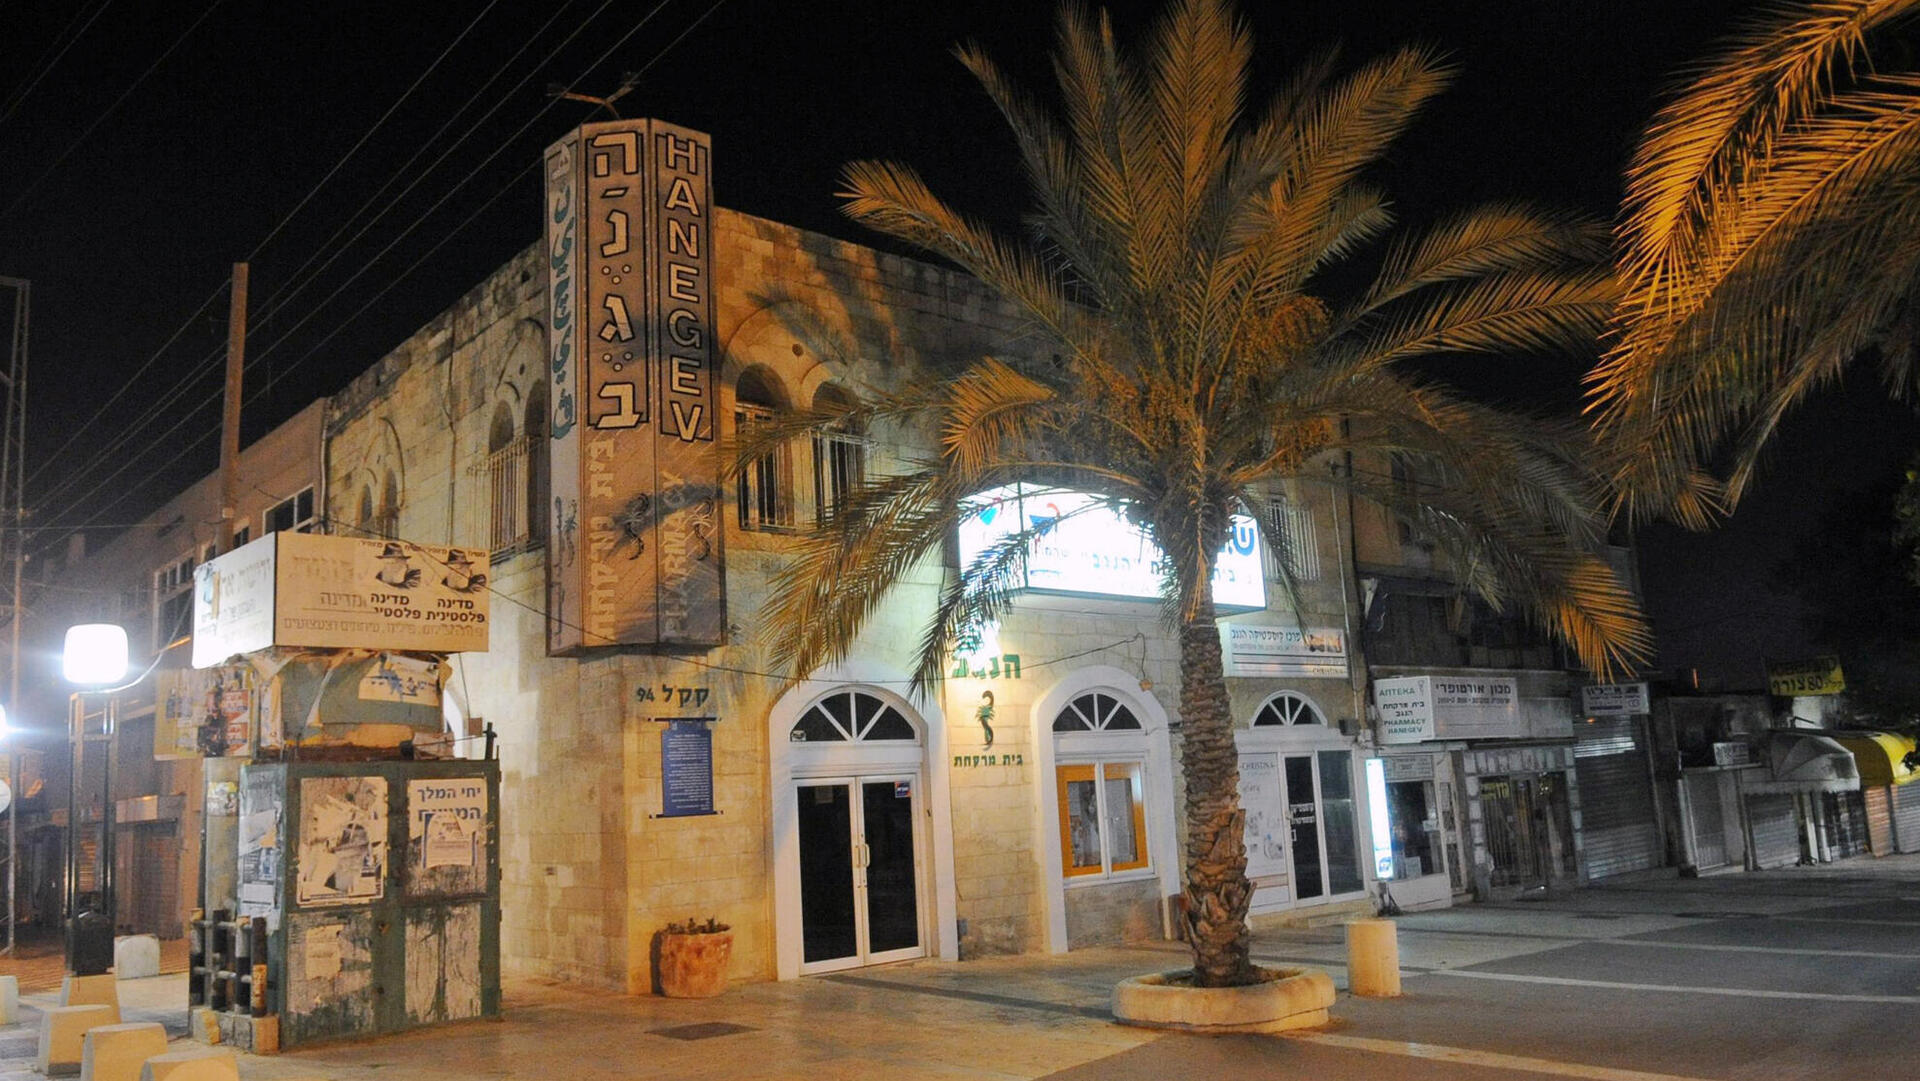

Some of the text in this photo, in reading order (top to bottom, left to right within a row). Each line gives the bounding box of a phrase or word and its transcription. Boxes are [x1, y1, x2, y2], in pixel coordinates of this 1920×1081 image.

[666, 133, 707, 443] HANEGEV
[370, 592, 411, 607] מדינה
[437, 597, 475, 610] מדינה
[425, 610, 486, 624] פלסטינית
[1231, 629, 1247, 640] הנגב
[637, 687, 656, 702] 94
[1436, 683, 1511, 697] מכון אורטופדי
[1382, 701, 1426, 711] בית מרקחת
[1395, 709, 1414, 718] הנגב
[1383, 717, 1426, 727] PHARMACY
[1388, 727, 1423, 736] HANEGEV
[953, 754, 1024, 769] בית מרקחת
[416, 785, 481, 803] יחי המלך
